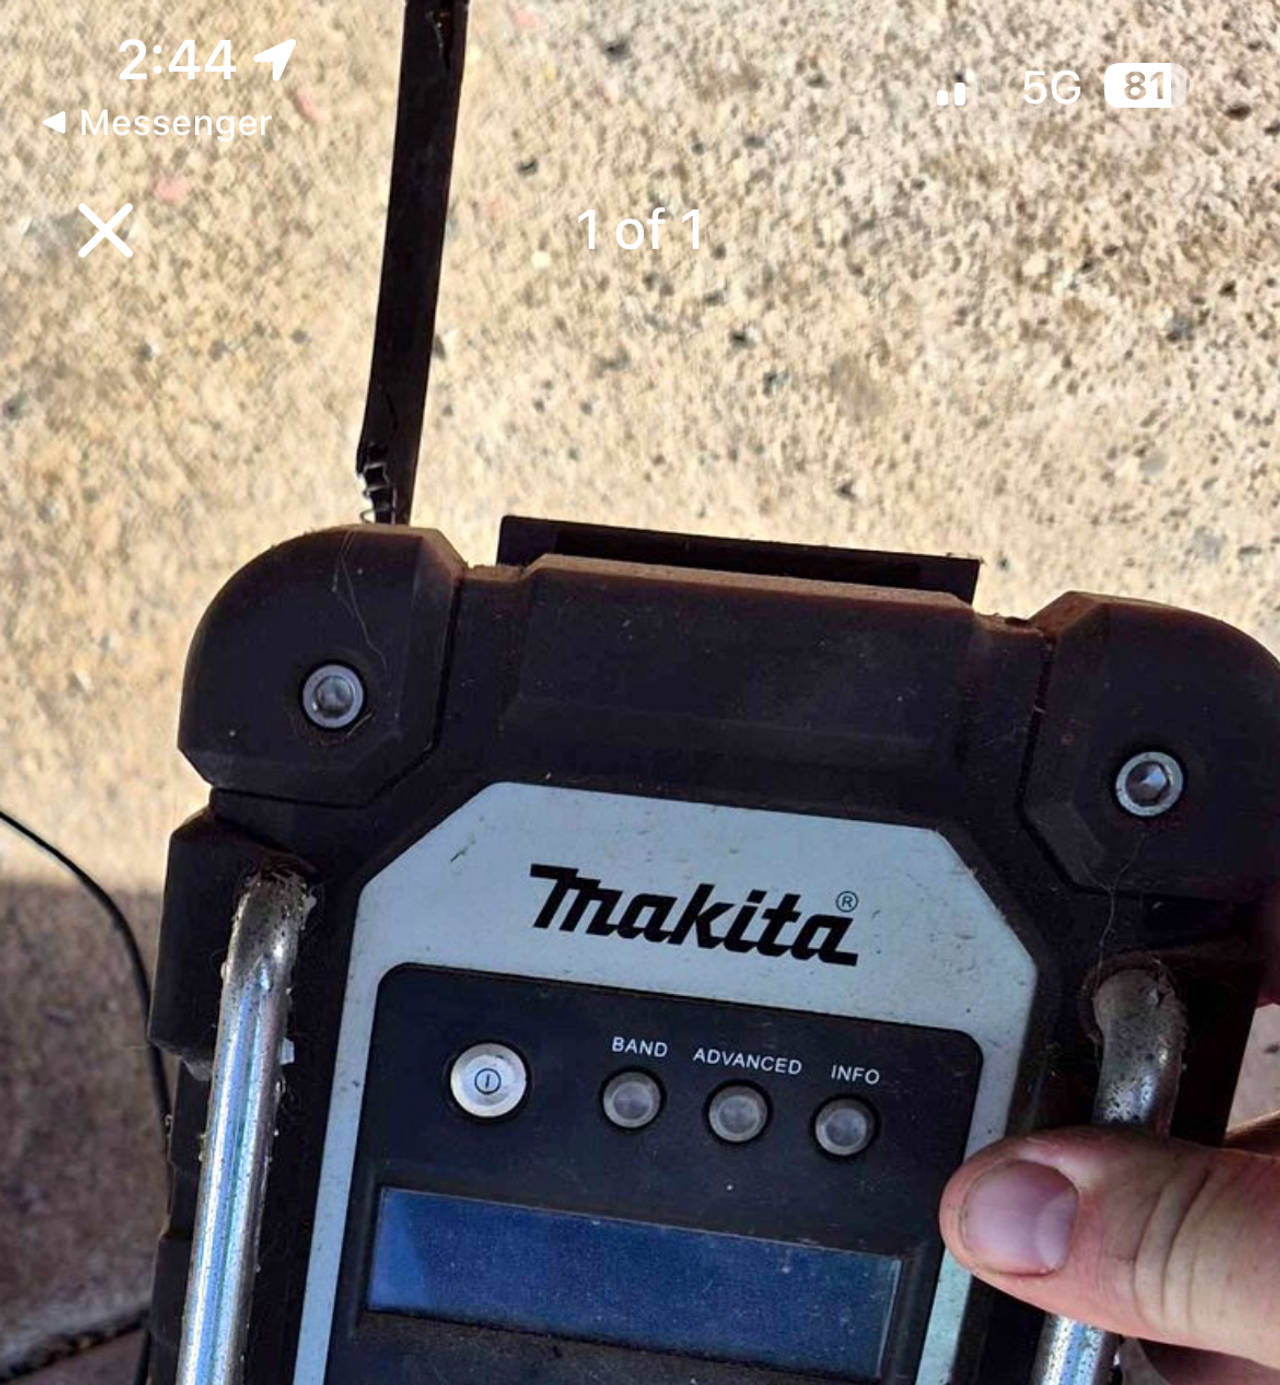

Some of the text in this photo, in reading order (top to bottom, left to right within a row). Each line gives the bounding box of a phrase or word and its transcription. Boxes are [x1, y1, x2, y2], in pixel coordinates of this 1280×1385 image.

[611, 1036, 668, 1058] BAND
[693, 1047, 802, 1076] ADVANCED
[831, 1064, 880, 1086] INFO
